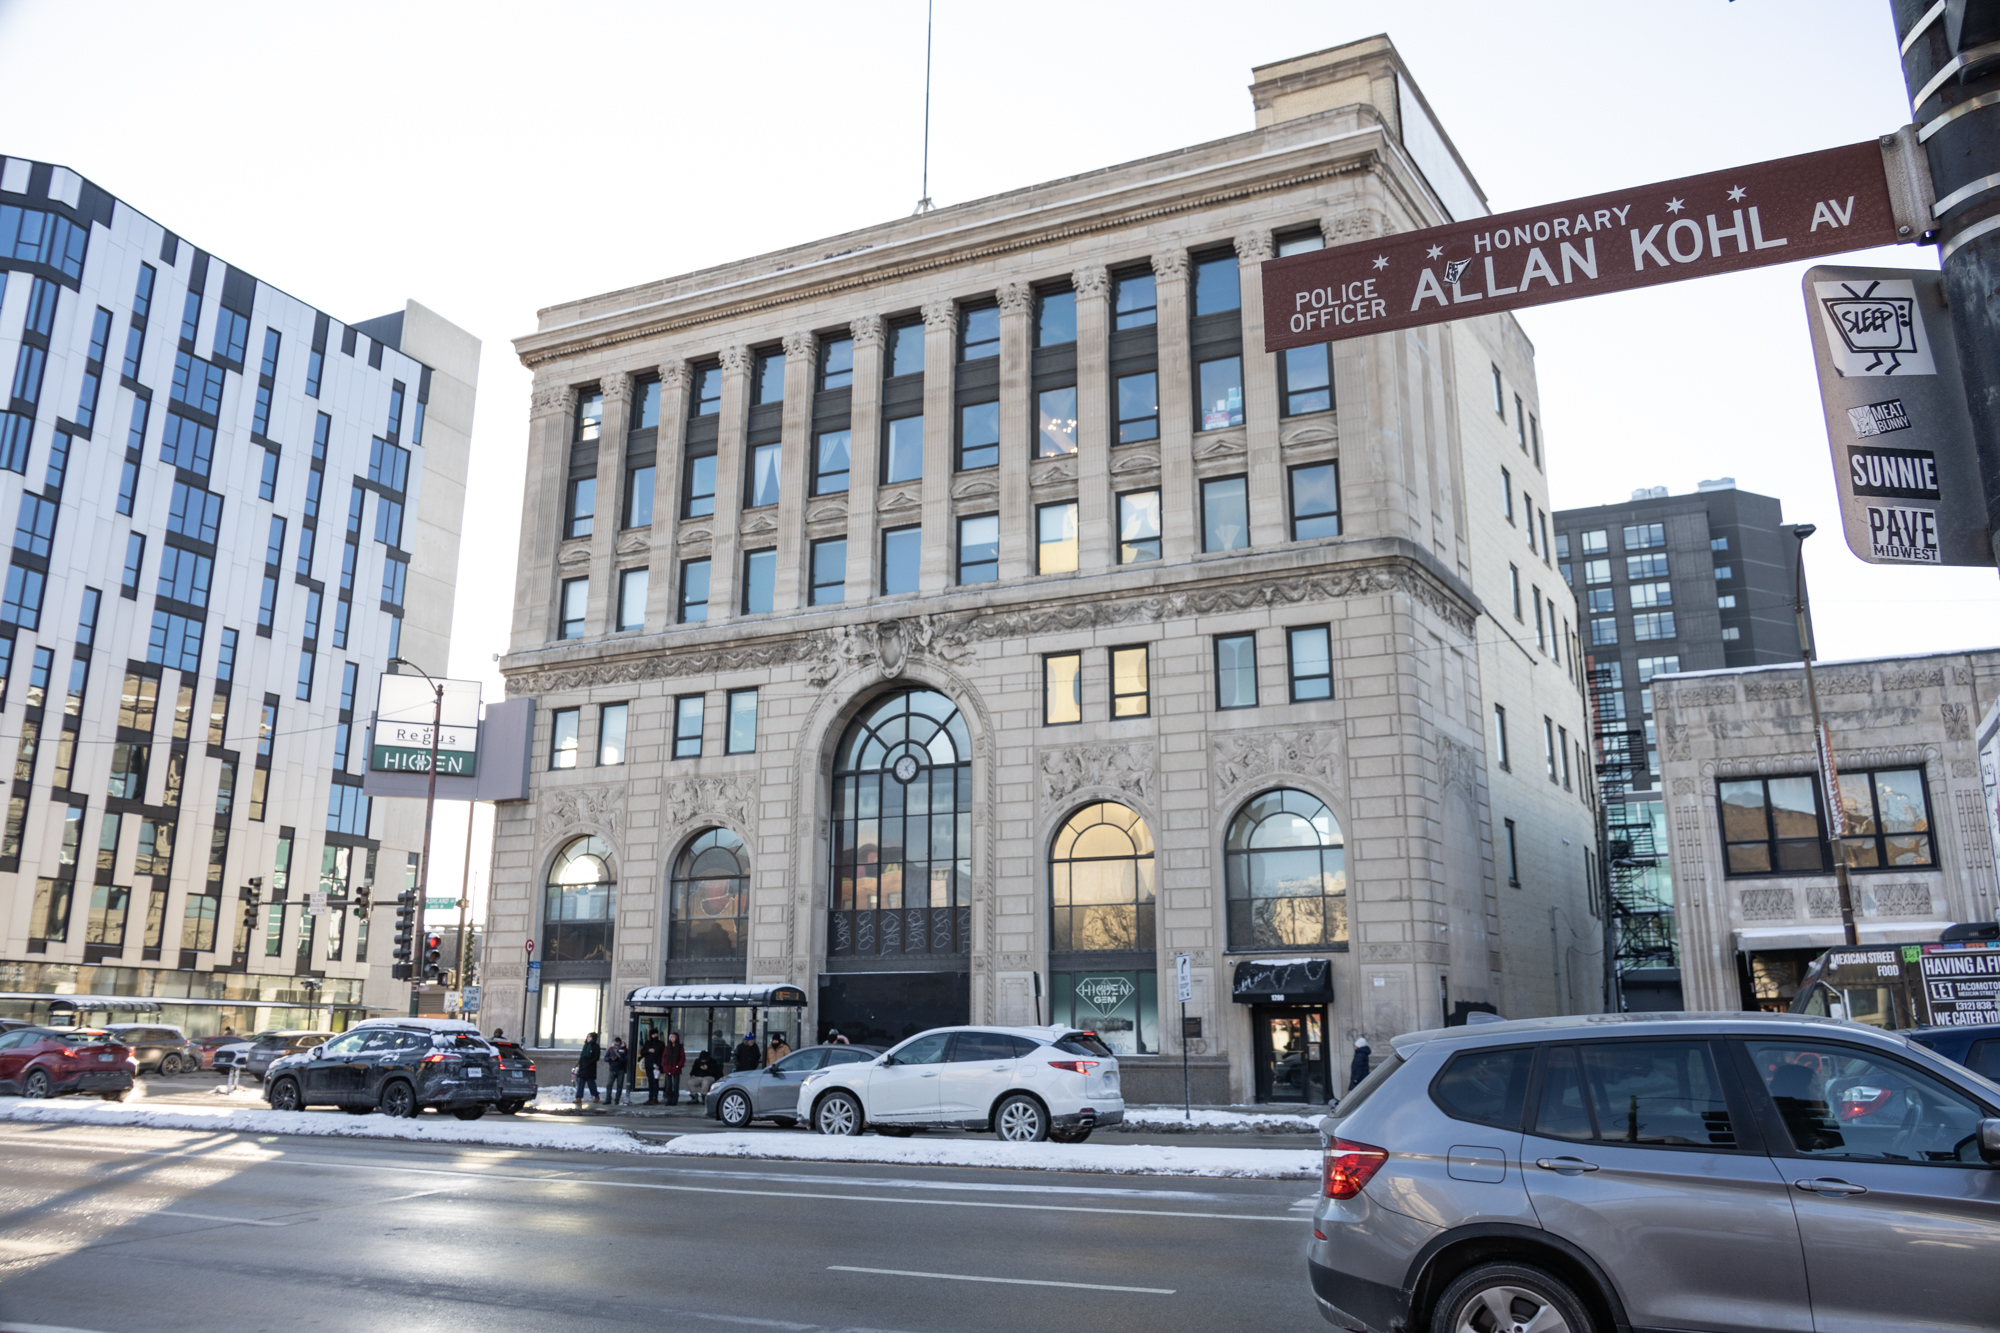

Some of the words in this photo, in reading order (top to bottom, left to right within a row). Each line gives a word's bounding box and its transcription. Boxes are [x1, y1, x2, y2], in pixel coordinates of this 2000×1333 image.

[1473, 204, 1631, 253] HONORARY
[1411, 237, 1598, 312] ALLAN
[1630, 205, 1788, 272] KOHL
[1809, 195, 1855, 233] AV
[1296, 278, 1377, 311] POLICE
[1290, 298, 1387, 334] OFFICER
[1841, 307, 1894, 334] SLEEP
[1870, 401, 1904, 421] MEAT
[1876, 415, 1909, 433] BUNNY
[1851, 454, 1938, 490] SUNNIE
[1867, 507, 1937, 550] PAVE
[1873, 544, 1938, 560] MIDWEST
[1830, 952, 1868, 965] MEXICAN
[1867, 951, 1896, 964] STREET
[1924, 956, 1975, 975] HAVING
[1976, 955, 1987, 973] A
[1986, 955, 2000, 973] FI
[1876, 964, 1900, 977] FOOD
[1093, 996, 1117, 1004] GEM
[1930, 983, 1954, 998] LET
[1955, 1001, 1976, 1011] (312)
[1934, 1011, 1952, 1026] WE
[1951, 1011, 1984, 1026] CATER
